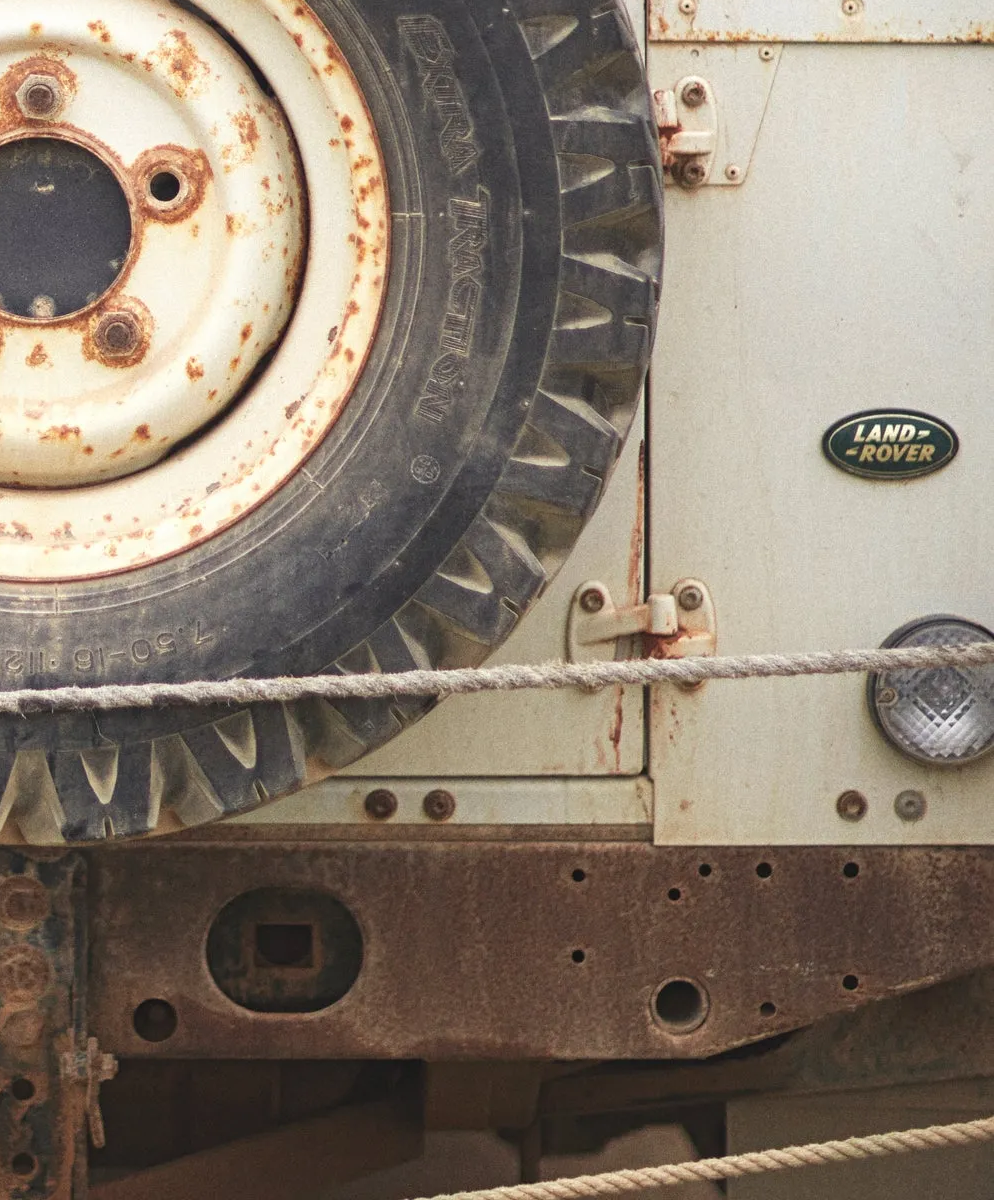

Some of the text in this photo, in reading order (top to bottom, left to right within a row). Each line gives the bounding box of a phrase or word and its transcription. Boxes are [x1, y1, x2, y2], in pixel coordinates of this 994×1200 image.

[853, 424, 916, 443] LAND
[858, 444, 936, 463] ROVER
[73, 619, 214, 674] 7.50-16
